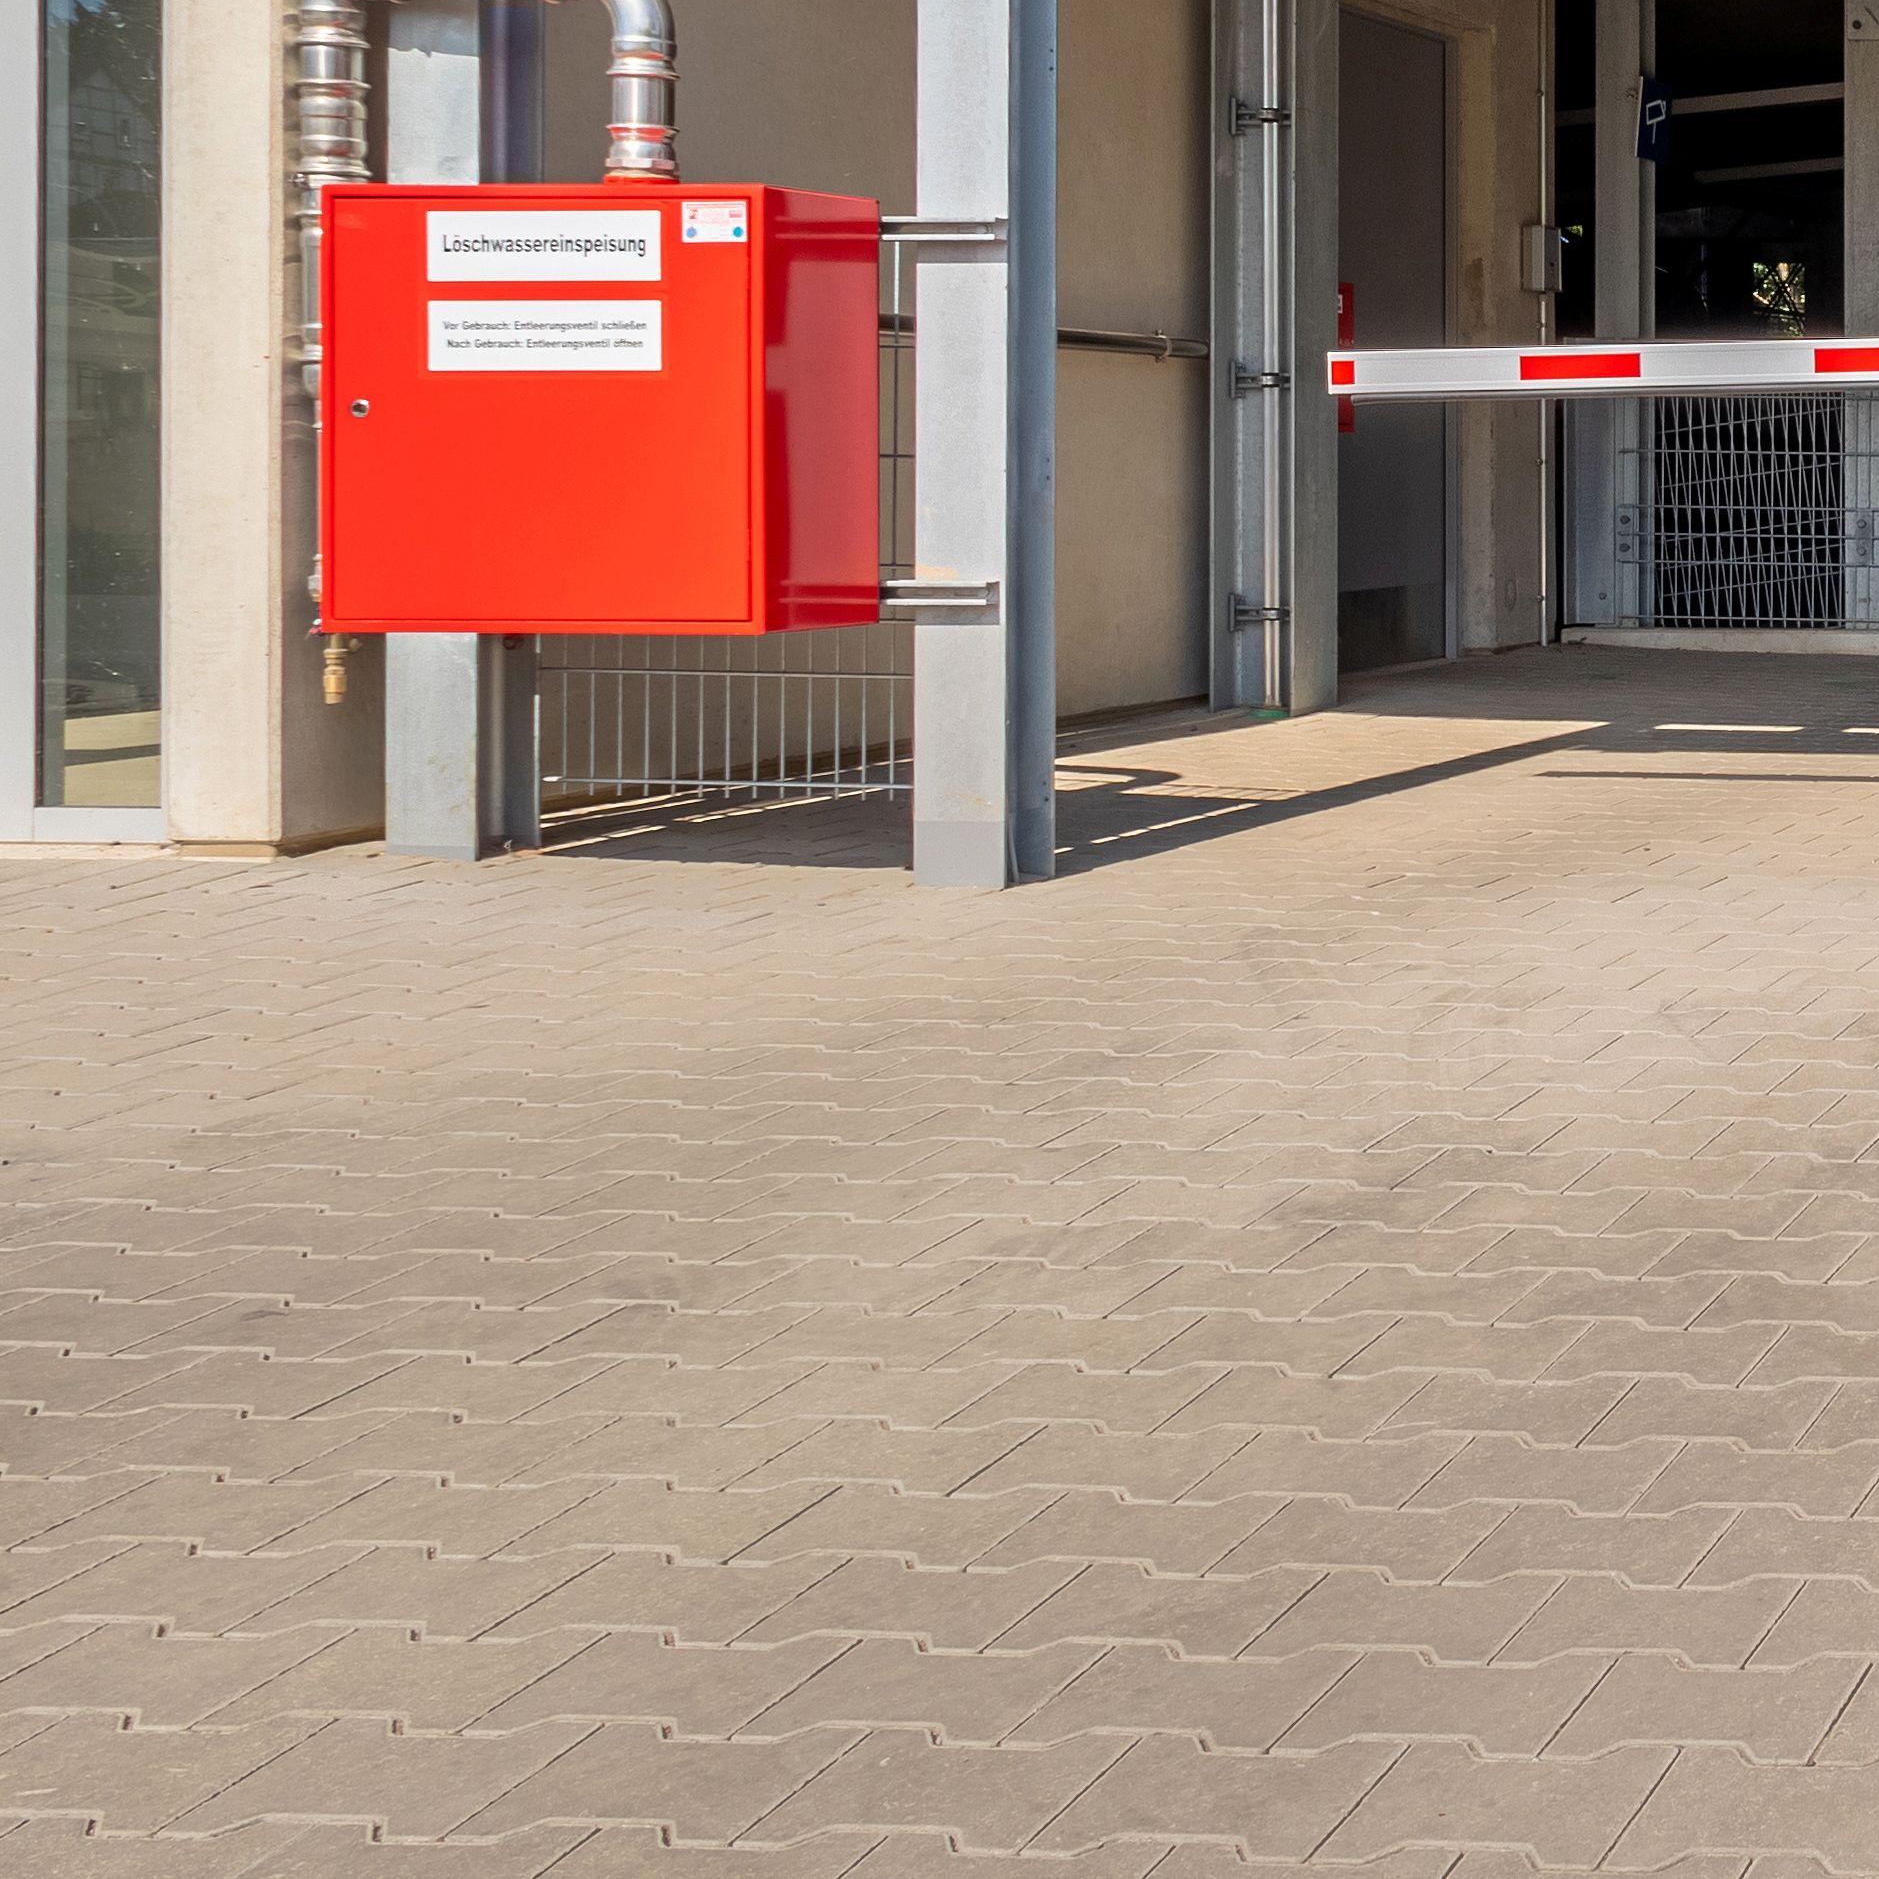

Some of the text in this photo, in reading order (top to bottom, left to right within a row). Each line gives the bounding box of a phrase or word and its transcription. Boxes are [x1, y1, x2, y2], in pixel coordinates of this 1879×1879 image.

[443, 234, 646, 258] Löschwassereinspeisung
[442, 320, 647, 333] Vor Gebrauch: Entleerungsventil schließen
[447, 338, 643, 351] Nach Gebrauch: Entleerungsventil öffnen
